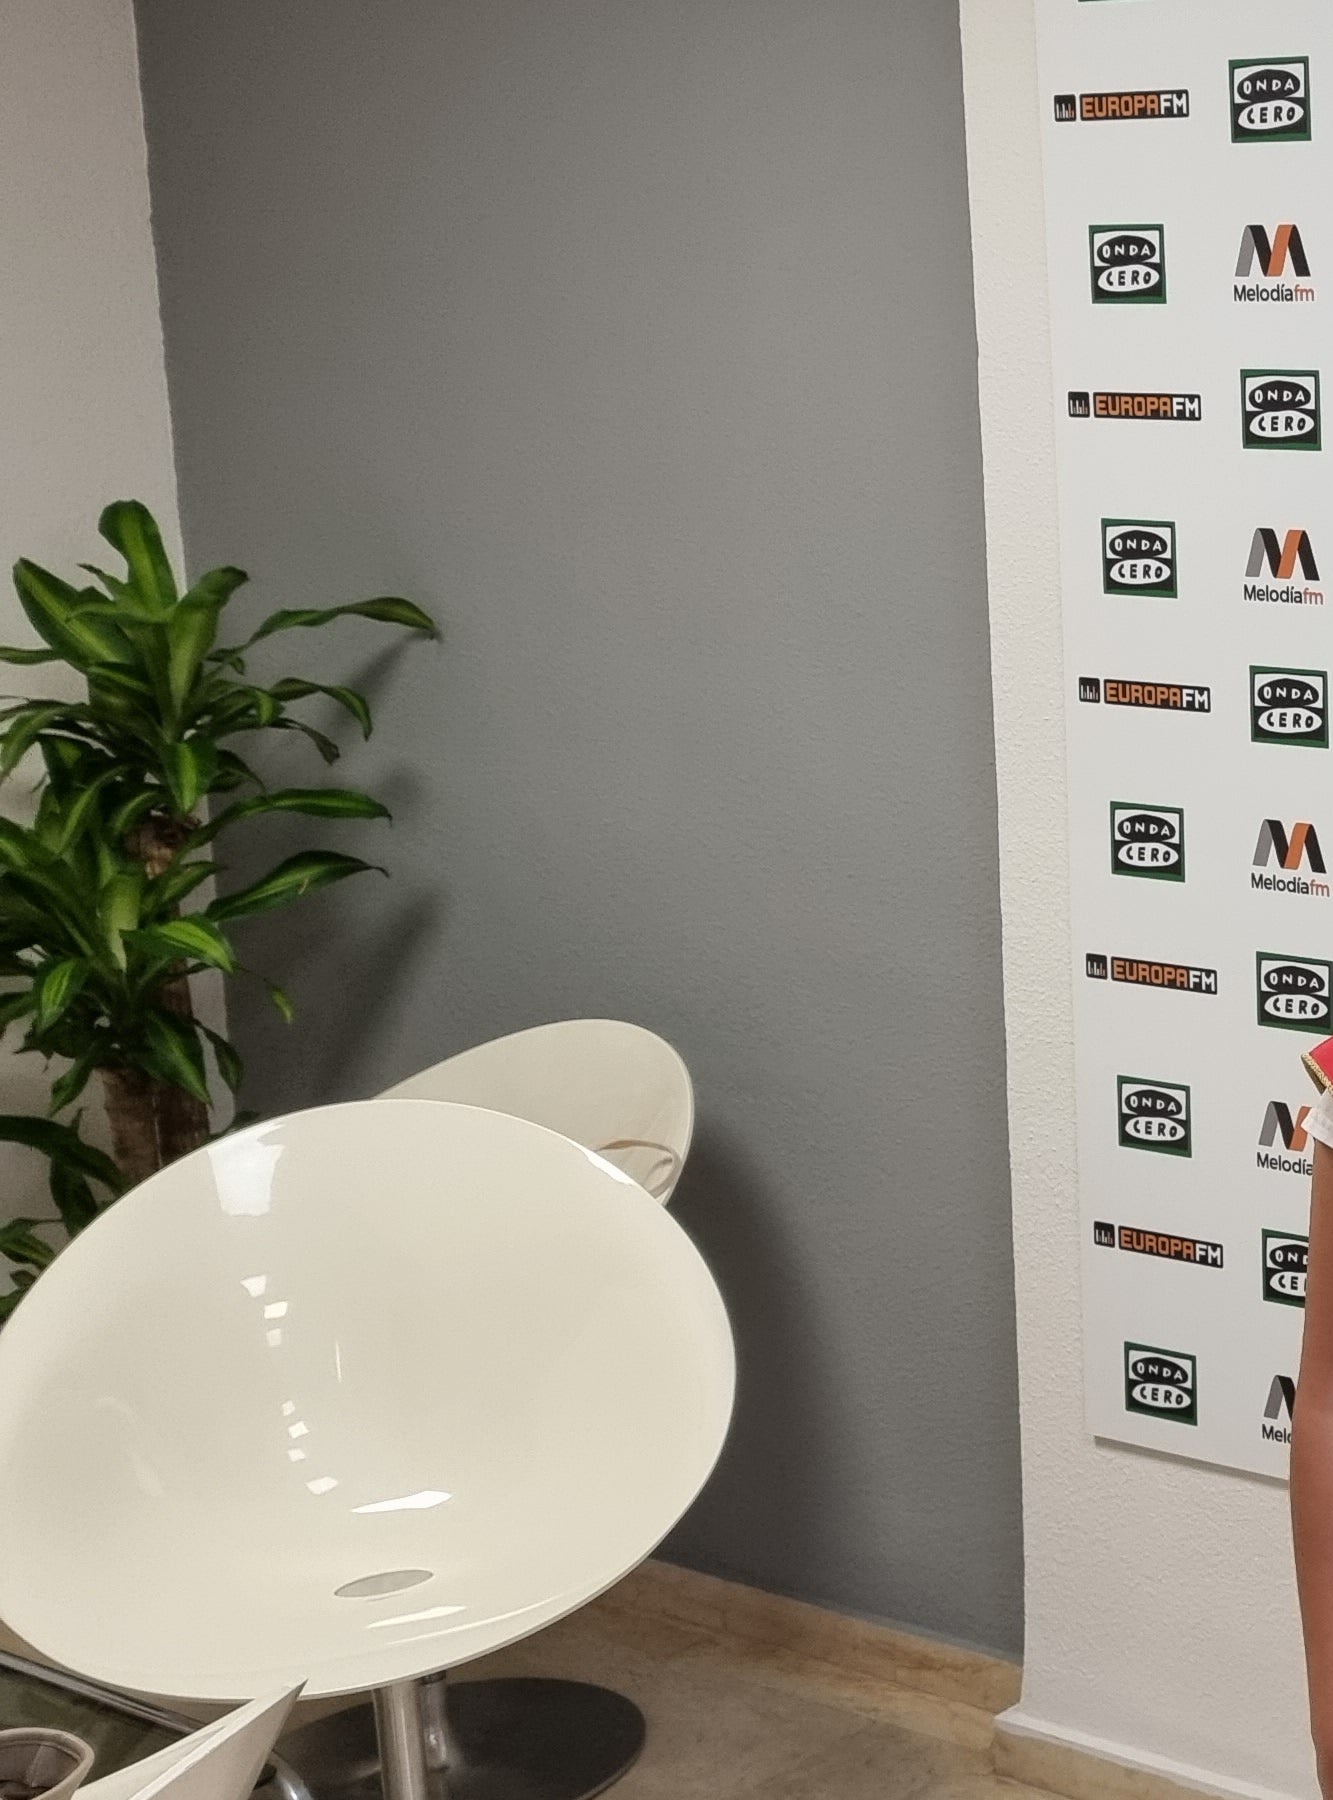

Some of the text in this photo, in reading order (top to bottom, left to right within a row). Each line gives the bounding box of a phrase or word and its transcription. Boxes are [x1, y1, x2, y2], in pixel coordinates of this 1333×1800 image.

[1242, 78, 1294, 94] ONDA
[1247, 106, 1295, 124] CERO
[1102, 244, 1151, 258] ONDA
[1106, 270, 1151, 286] CERO
[1254, 389, 1305, 403] ONDA
[1258, 416, 1306, 432] CERO
[1114, 538, 1162, 551] ONDA
[1118, 564, 1163, 579] CERO
[1263, 686, 1313, 700] ONDA
[1266, 712, 1314, 728] CERO
[1123, 821, 1170, 836] ONDA
[1126, 846, 1171, 863] CERO
[1270, 972, 1319, 989] ONDA
[1273, 997, 1320, 1015] CERO
[1130, 1095, 1177, 1112] ONDA
[1133, 1120, 1177, 1138] CERO
[1257, 1152, 1312, 1176] Melodía
[1275, 1248, 1308, 1265] ON
[1276, 1272, 1304, 1290] CE
[1137, 1362, 1183, 1380] ONDA
[1140, 1386, 1183, 1405] CERO
